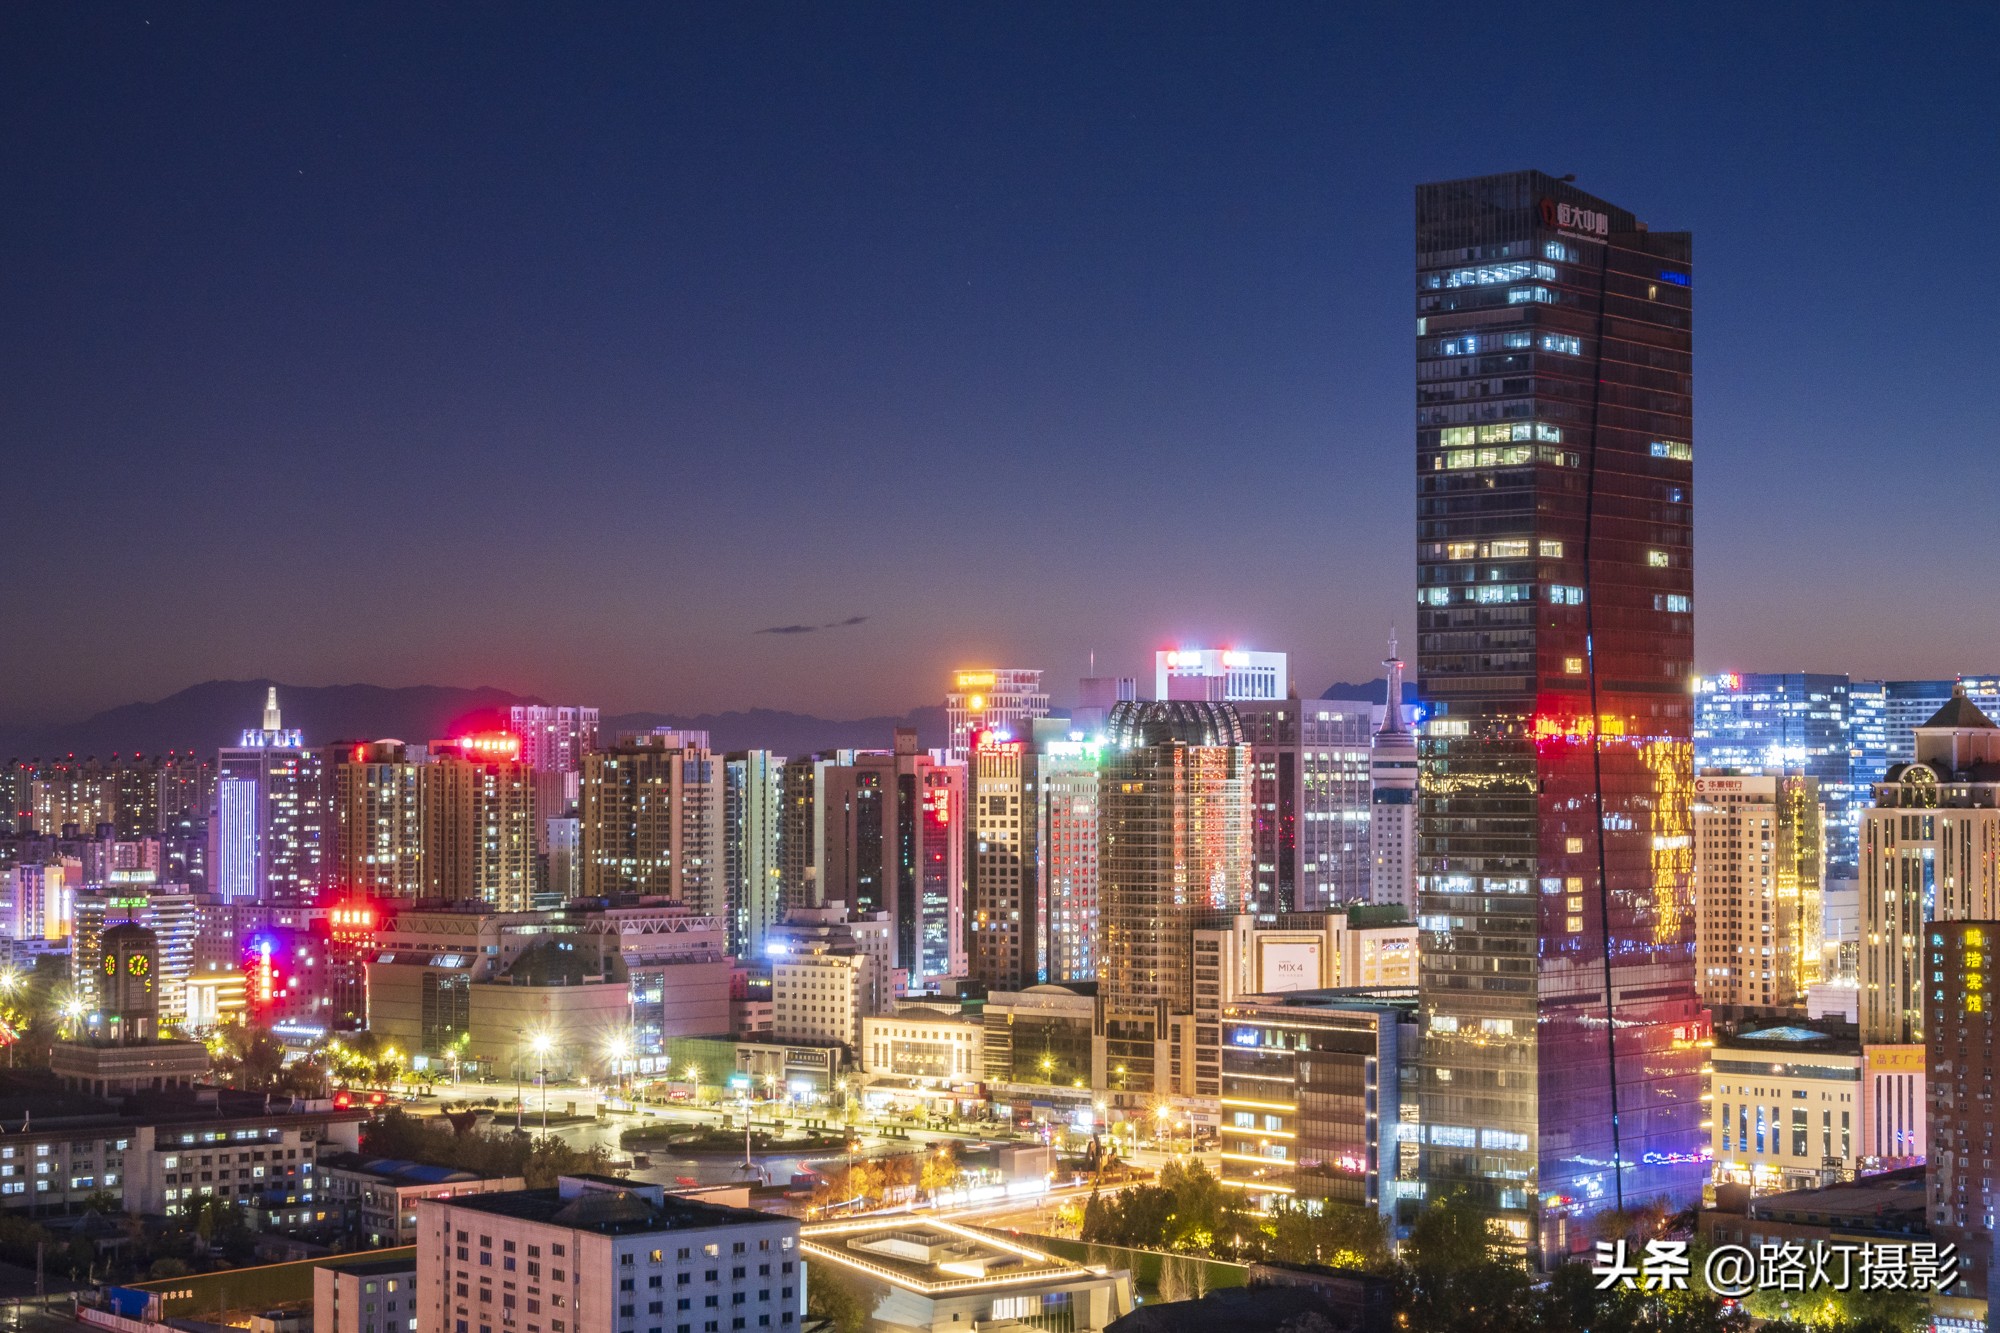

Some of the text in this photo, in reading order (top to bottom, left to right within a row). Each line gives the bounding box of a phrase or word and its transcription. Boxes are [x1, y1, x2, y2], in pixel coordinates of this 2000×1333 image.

[1557, 202, 1608, 236] 恒大中心
[1708, 780, 1742, 789] 华夏银行
[1278, 963, 1303, 972] MIX 4
[1965, 929, 1983, 1012] 鹏浩宾馆
